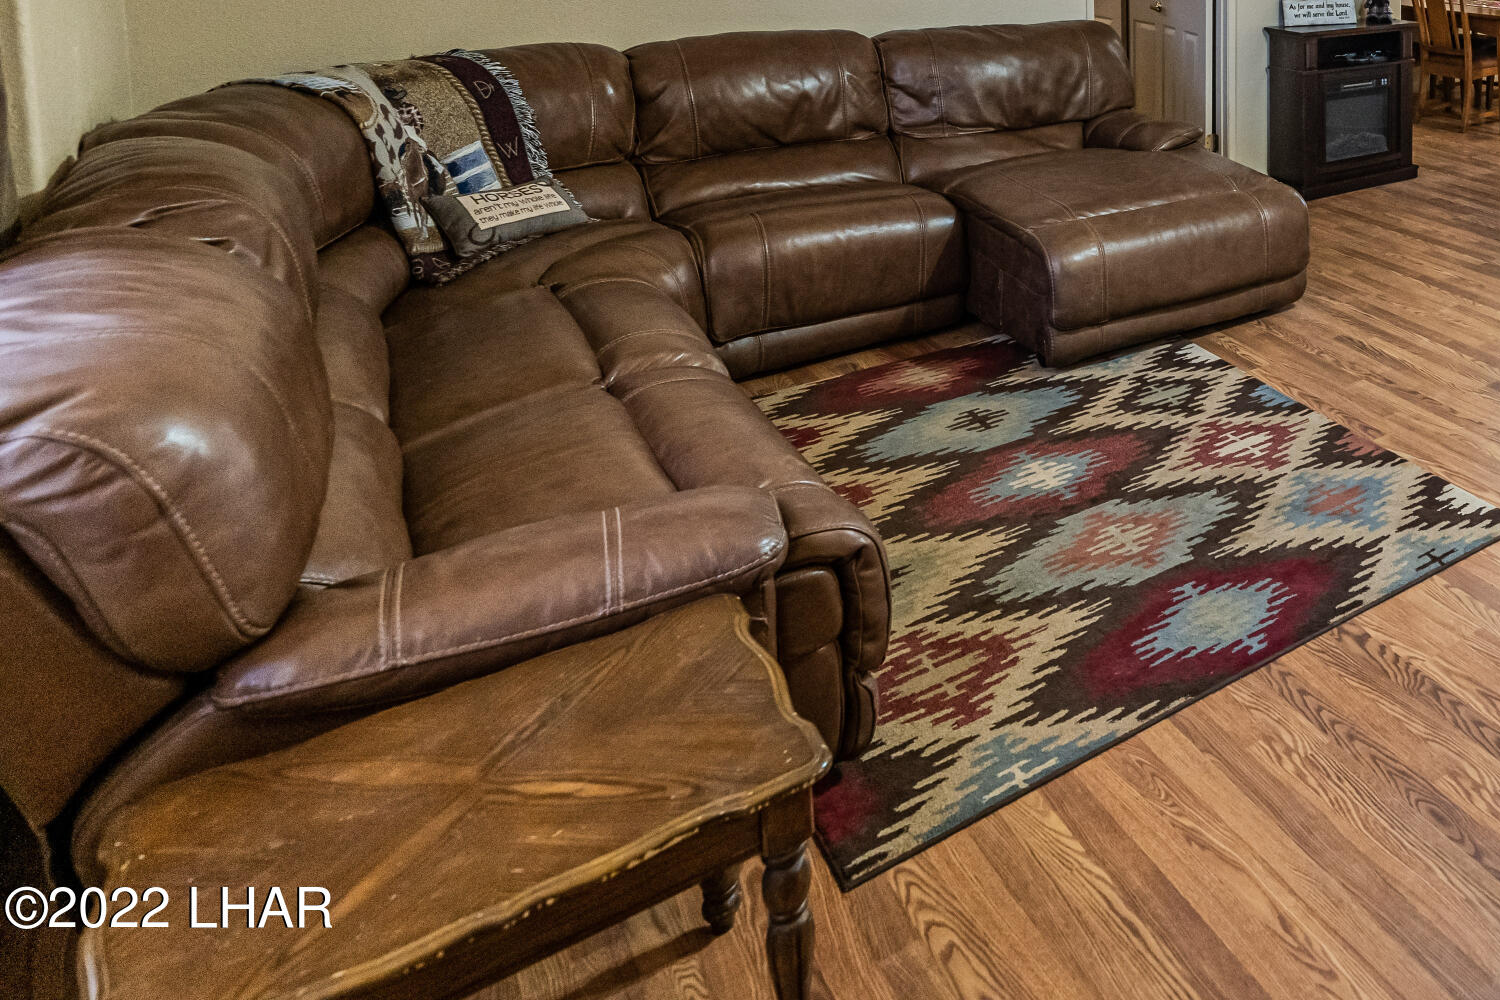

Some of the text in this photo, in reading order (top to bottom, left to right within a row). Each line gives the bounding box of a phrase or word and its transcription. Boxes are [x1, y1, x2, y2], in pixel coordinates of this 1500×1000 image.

[1297, 3, 1305, 11] for
[1326, 3, 1334, 11] my
[470, 185, 543, 204] HORSES
[503, 200, 520, 210] my
[479, 214, 499, 224] they
[499, 209, 521, 219] make
[521, 206, 534, 214] my
